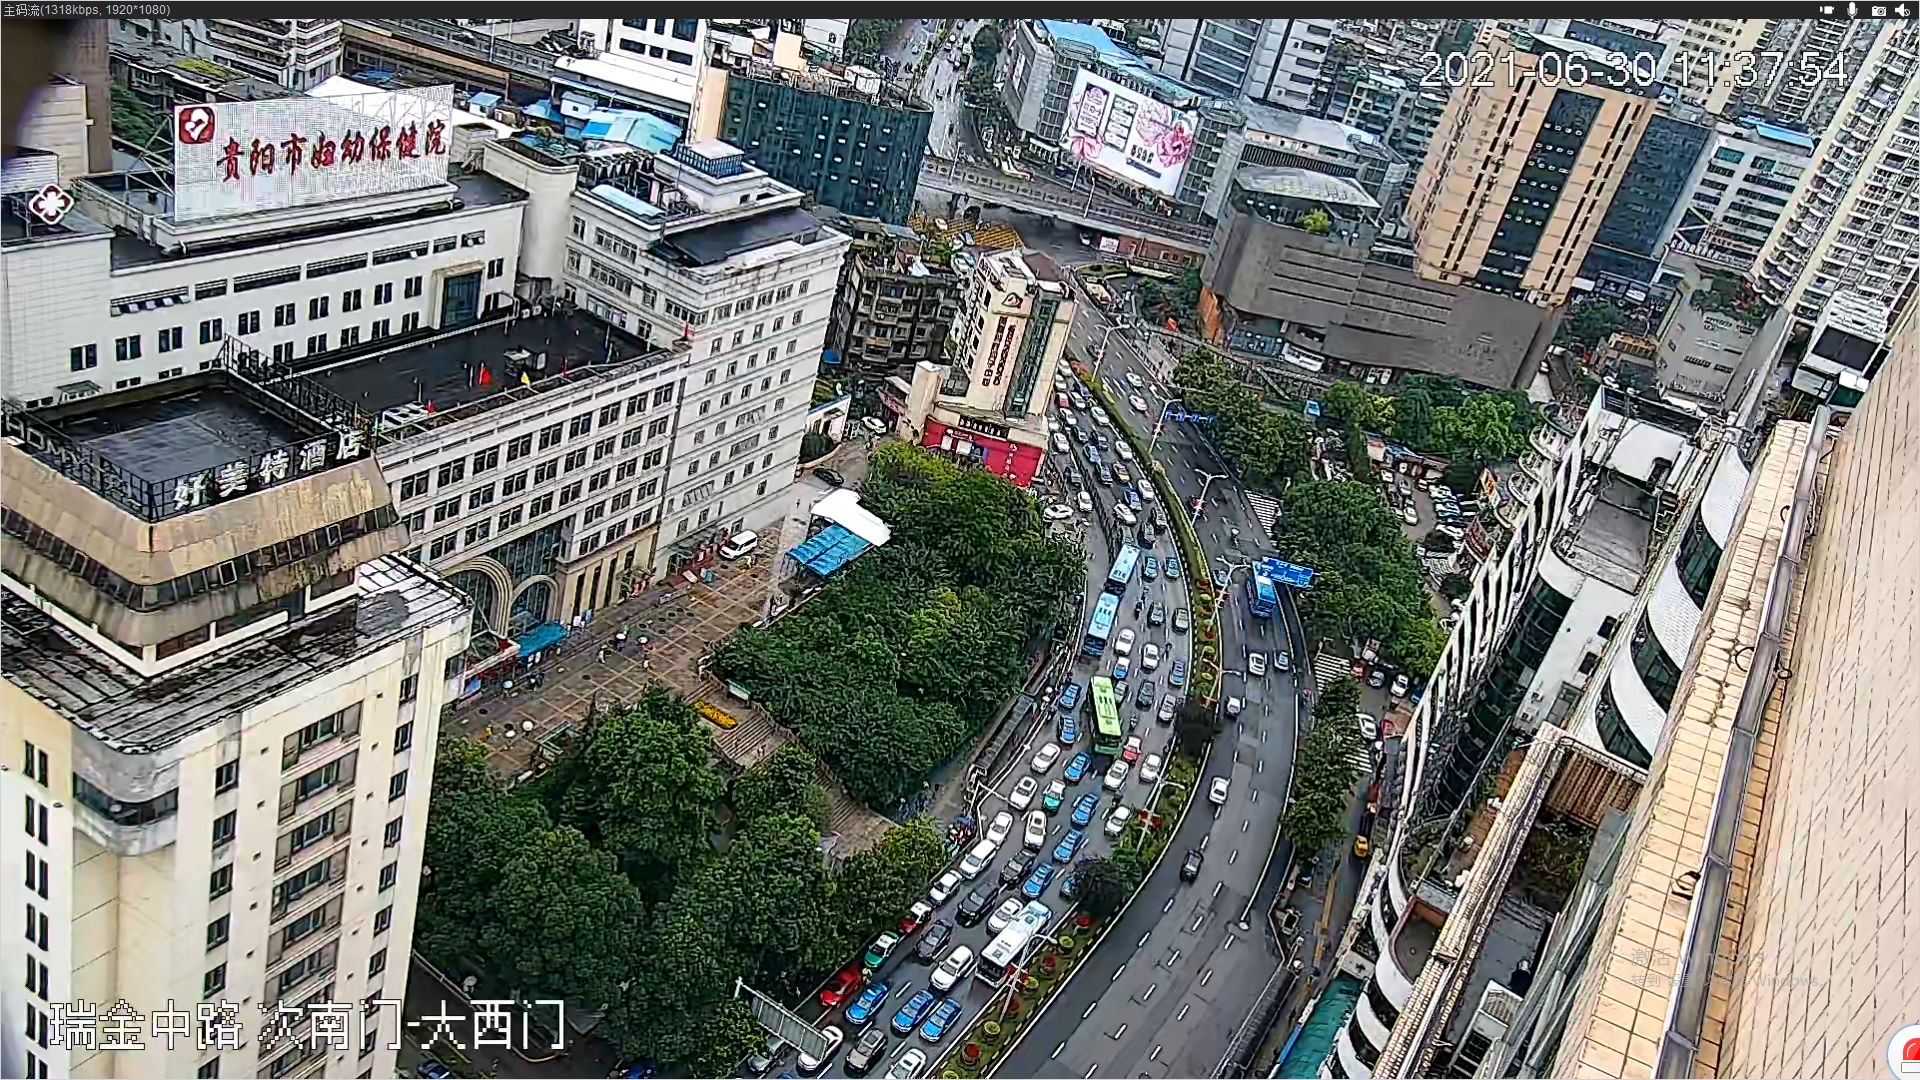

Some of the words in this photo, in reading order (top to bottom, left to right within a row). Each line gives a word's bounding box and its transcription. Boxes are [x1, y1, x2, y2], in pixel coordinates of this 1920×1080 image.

[216, 118, 446, 183] 贵阳市妇幼保健院
[173, 427, 366, 511] 好美特酒店
